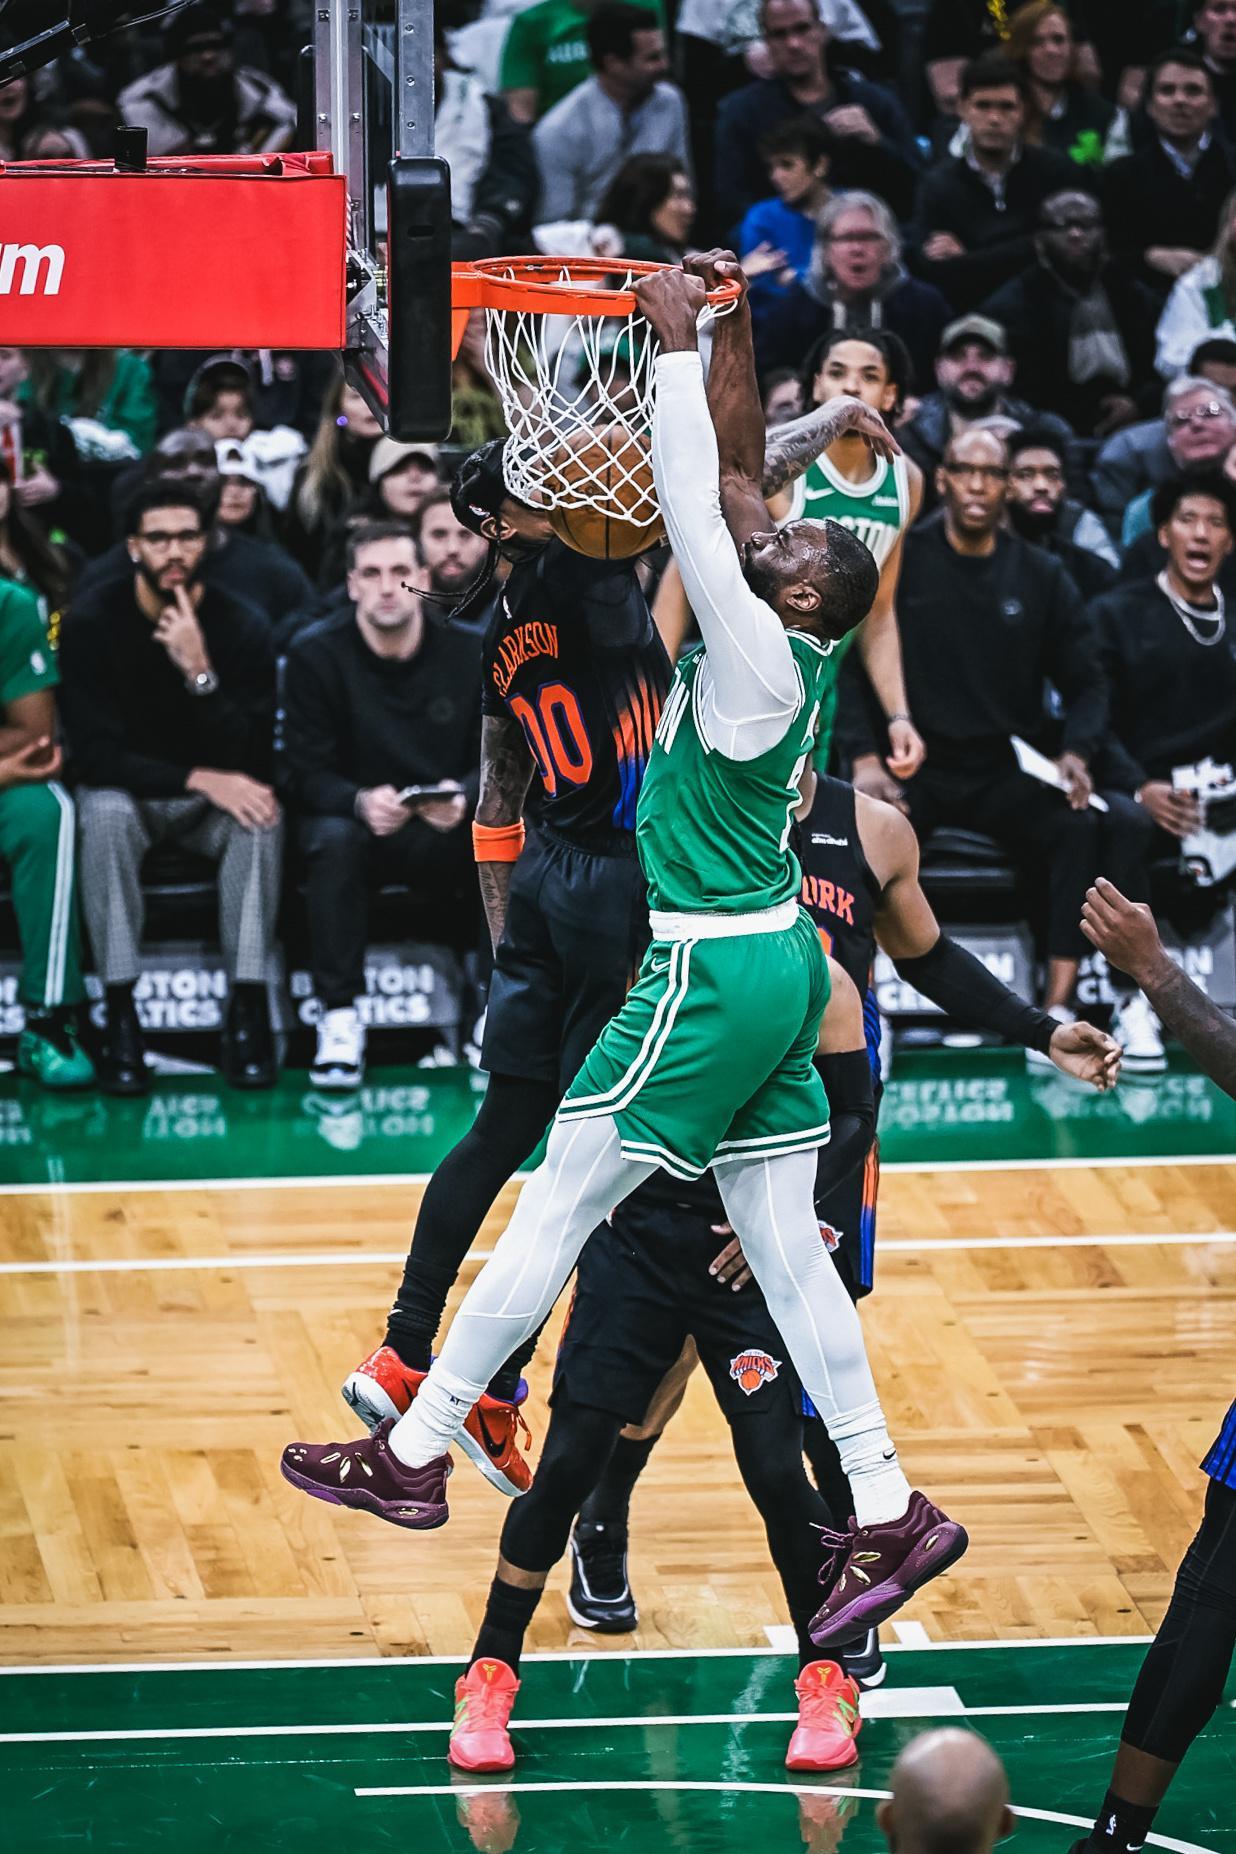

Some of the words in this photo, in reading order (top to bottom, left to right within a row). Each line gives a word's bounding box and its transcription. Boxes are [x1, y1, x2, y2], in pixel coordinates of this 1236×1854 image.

[0, 243, 65, 295] m
[493, 620, 558, 697] CLARKSON
[801, 874, 855, 926] ORK
